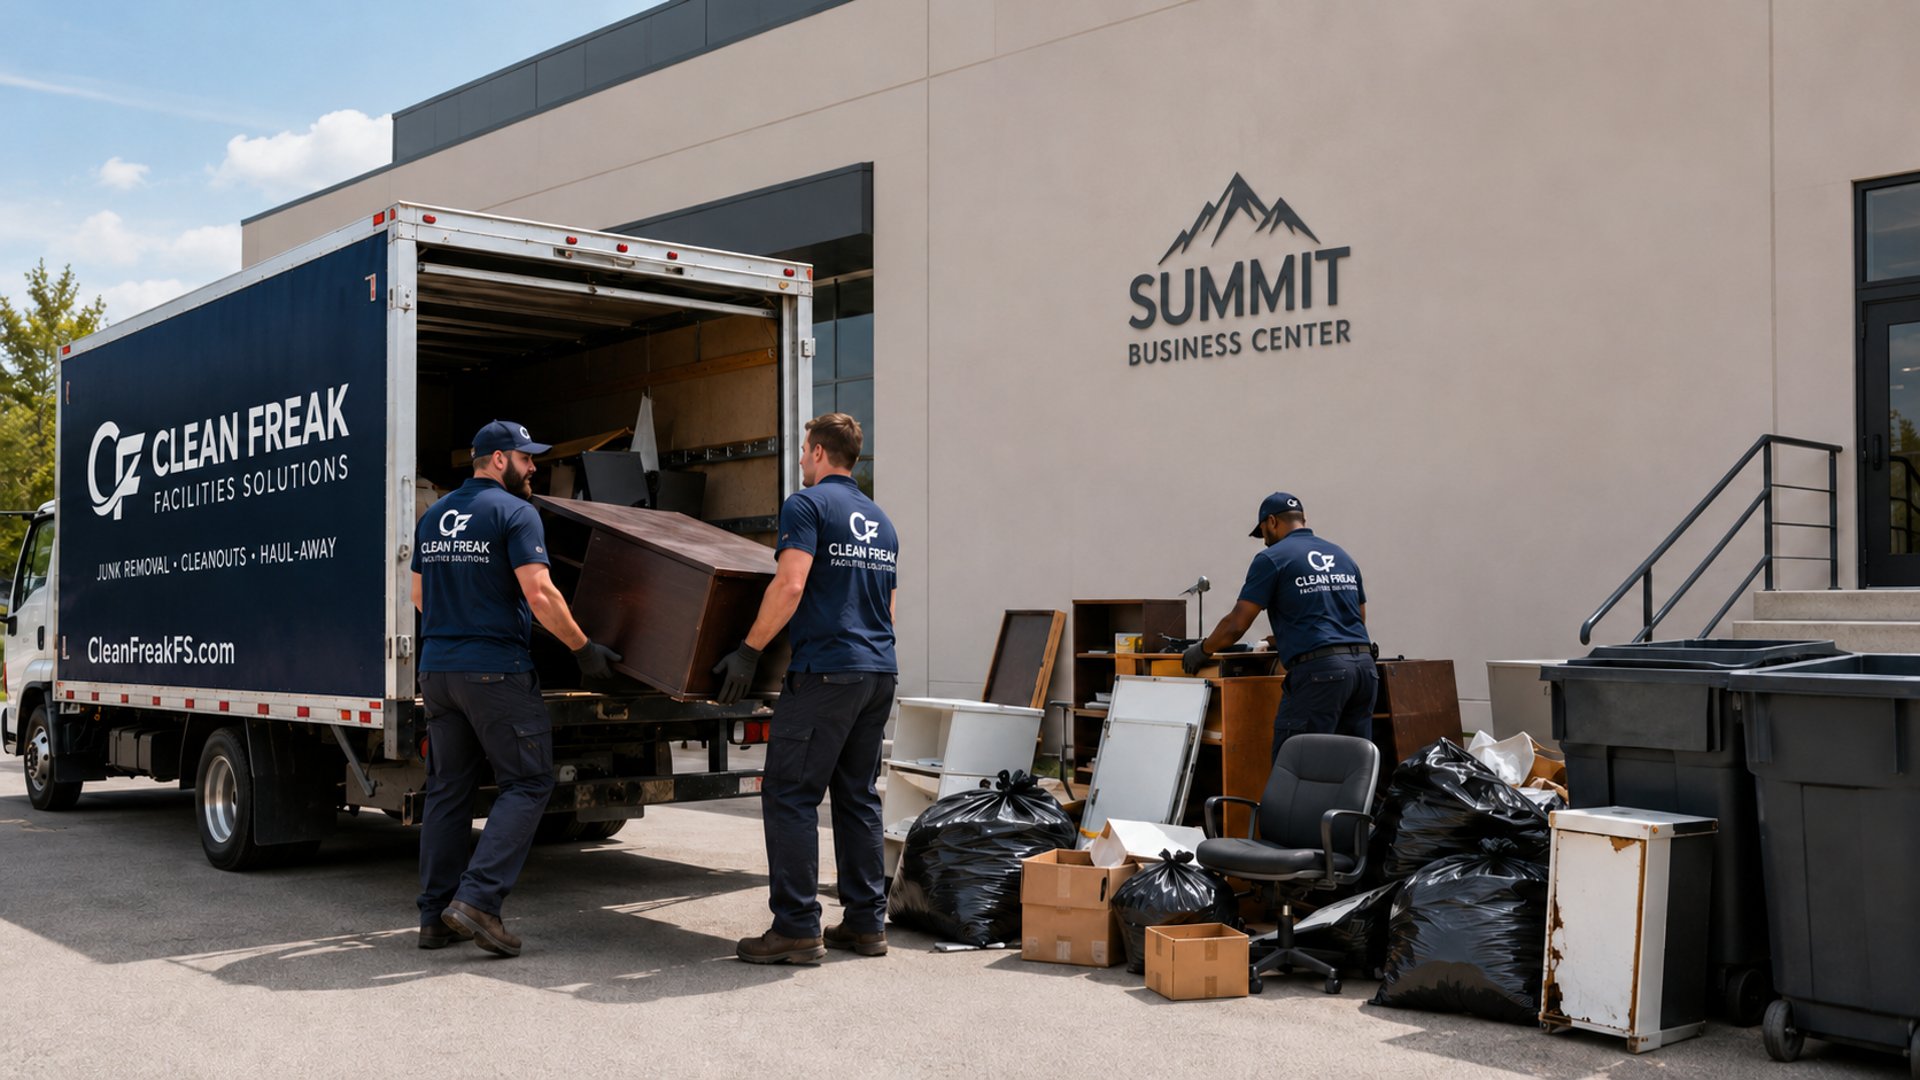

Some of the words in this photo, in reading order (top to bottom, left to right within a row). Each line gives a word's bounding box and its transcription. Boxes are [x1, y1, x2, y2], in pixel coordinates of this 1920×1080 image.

[1129, 246, 1350, 330] SUMMIT
[1128, 331, 1242, 366] BUSINESS
[1251, 319, 1351, 352] CENTER
[152, 411, 239, 477] CLEAN
[248, 383, 350, 457] FREAK
[154, 476, 235, 514] FACILITIES
[242, 454, 348, 498] SOLUTIONS
[96, 561, 122, 581] JUNK
[124, 556, 170, 578] REMOVAL
[180, 546, 247, 572] CLEANOUTS
[260, 537, 337, 564] HAUL-AWAY
[420, 541, 451, 554] CLEAN
[453, 541, 490, 554] FREAK
[828, 542, 867, 559] CLEAN
[868, 547, 896, 564] FREAK
[1295, 574, 1329, 587] CLEAN
[1330, 573, 1358, 585] FREAK
[88, 635, 235, 664] CleanFreakFS.com
